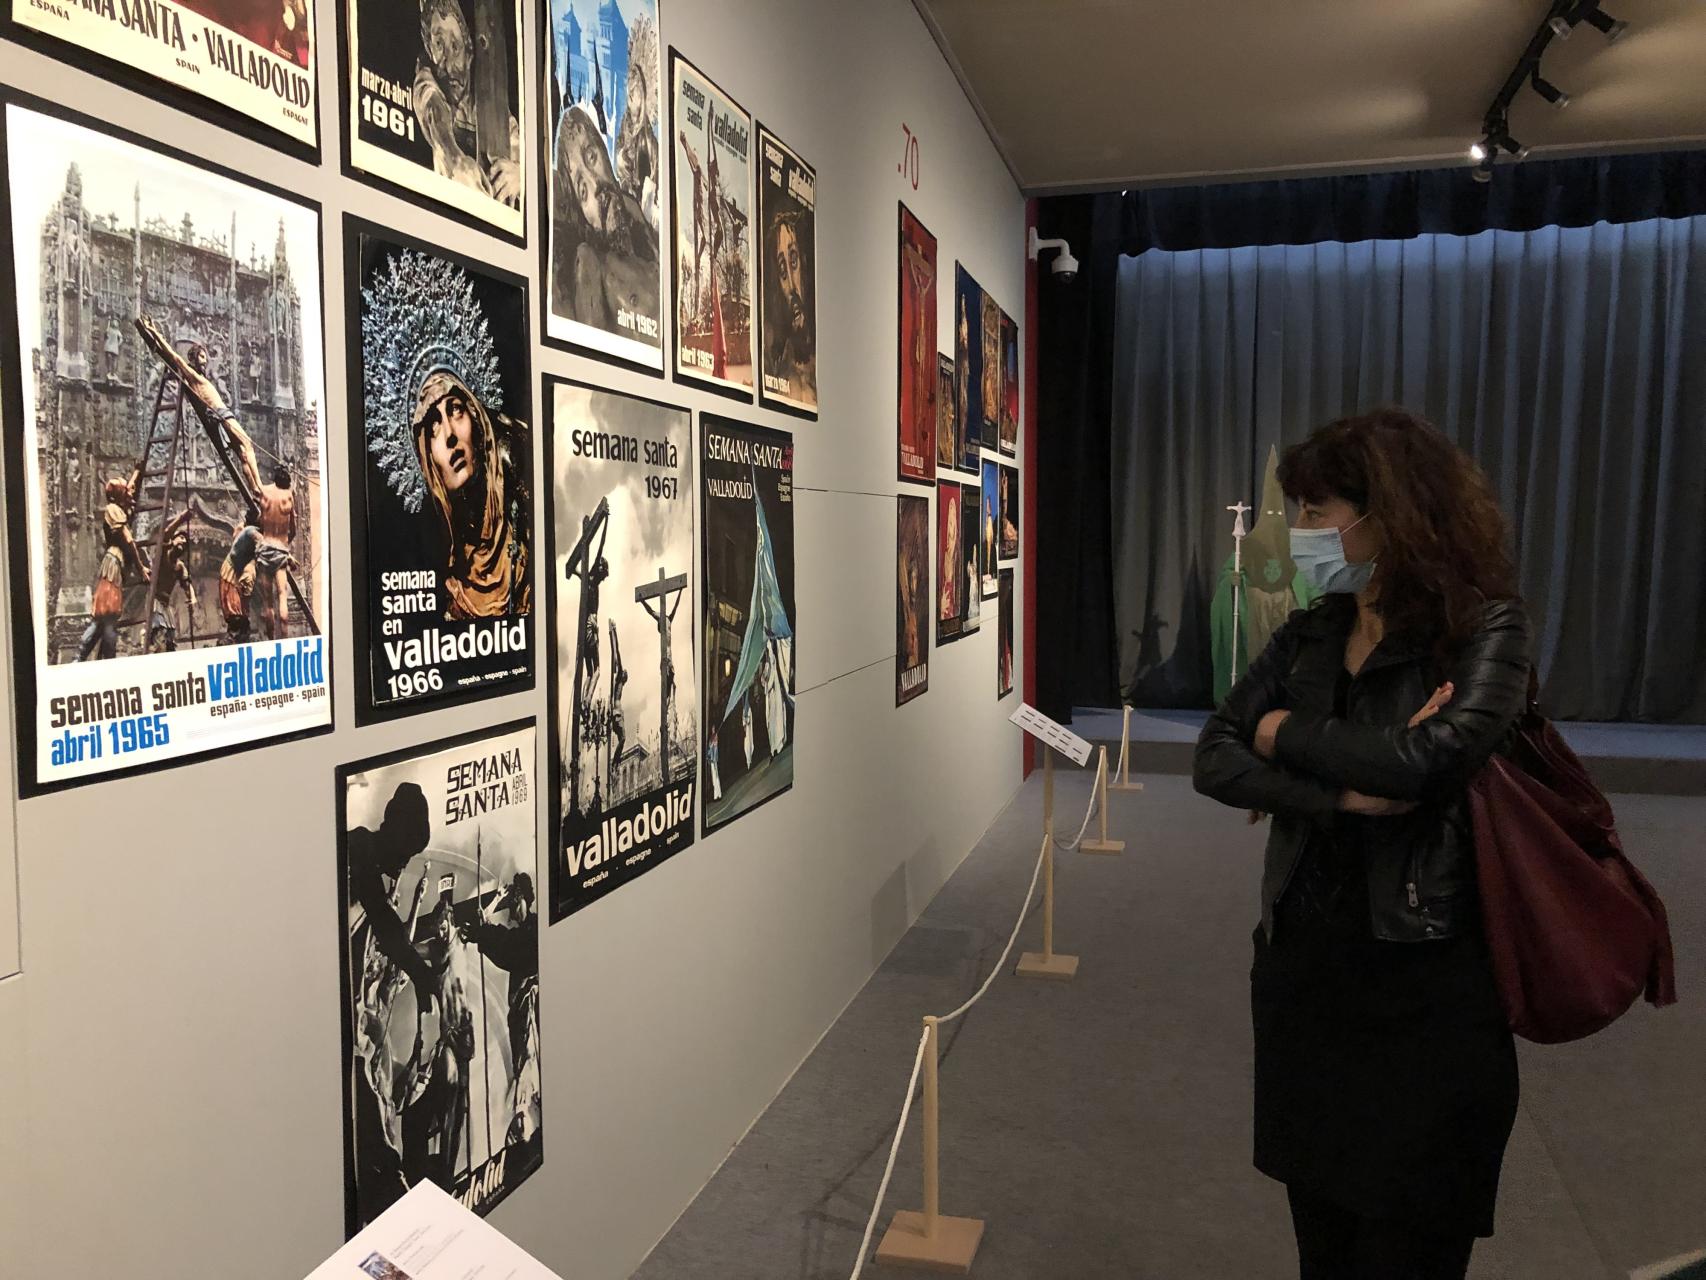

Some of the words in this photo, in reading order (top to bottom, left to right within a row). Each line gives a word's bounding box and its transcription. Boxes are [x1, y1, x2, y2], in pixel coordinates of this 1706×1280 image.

[176, 58, 200, 74] SPAIN
[204, 27, 310, 109] VALLADOLID
[361, 66, 413, 111] marzo-abril
[682, 80, 705, 109] semana
[283, 107, 309, 126] ESPAGNE
[362, 94, 415, 142] 1961
[687, 106, 702, 131] santa
[714, 112, 748, 157] valladolid
[617, 307, 636, 330] abril
[635, 313, 658, 338] 1962
[571, 429, 639, 463] semana
[643, 436, 678, 469] santa
[708, 434, 751, 465] SEMANA
[753, 443, 783, 469] SANTA
[645, 475, 678, 500] 1967
[380, 569, 436, 591] semana
[382, 590, 437, 615] santa
[382, 618, 403, 636] en
[383, 618, 527, 671] valladolid
[50, 685, 143, 728] semana
[151, 671, 206, 712] santa
[207, 637, 324, 701] valladolid
[387, 668, 444, 698] 1966
[210, 699, 248, 718] españa
[254, 691, 295, 712] espagne
[302, 686, 326, 703] spain
[51, 725, 103, 766] abril
[108, 713, 170, 755] 1965
[446, 747, 522, 795] SEMANA
[445, 781, 510, 826] SANTA
[566, 782, 692, 877] valladolid
[625, 848, 652, 866] espagne
